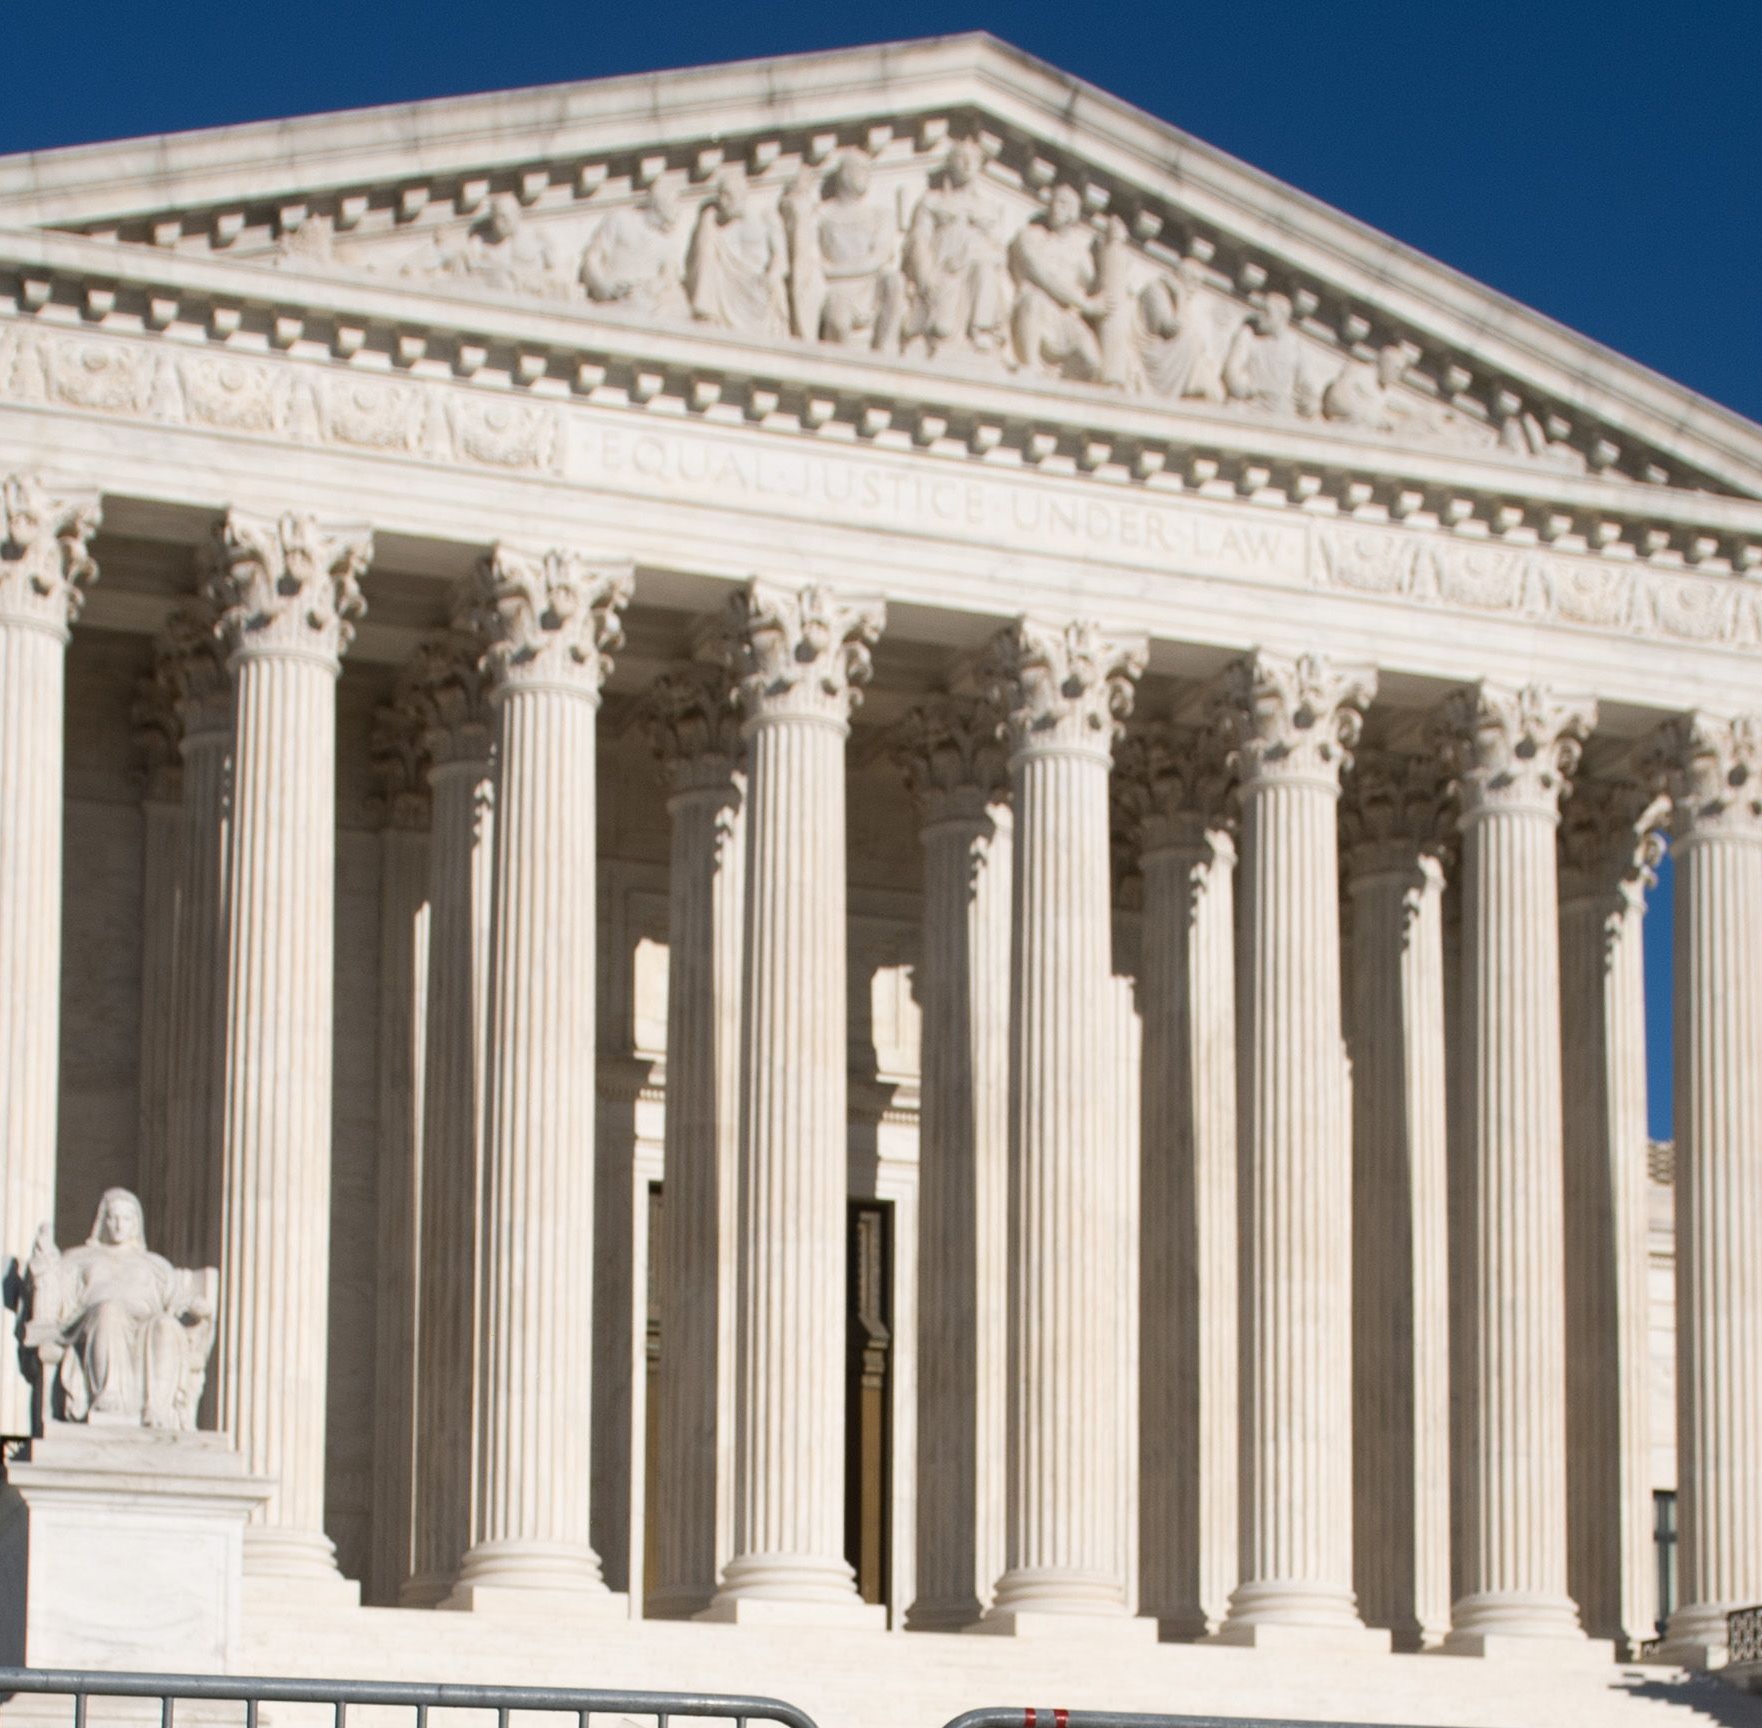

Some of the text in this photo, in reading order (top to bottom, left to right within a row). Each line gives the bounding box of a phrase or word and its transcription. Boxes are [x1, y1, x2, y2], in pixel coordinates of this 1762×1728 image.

[600, 430, 1282, 565] EQUAL JUSTICE UNDER LAW
